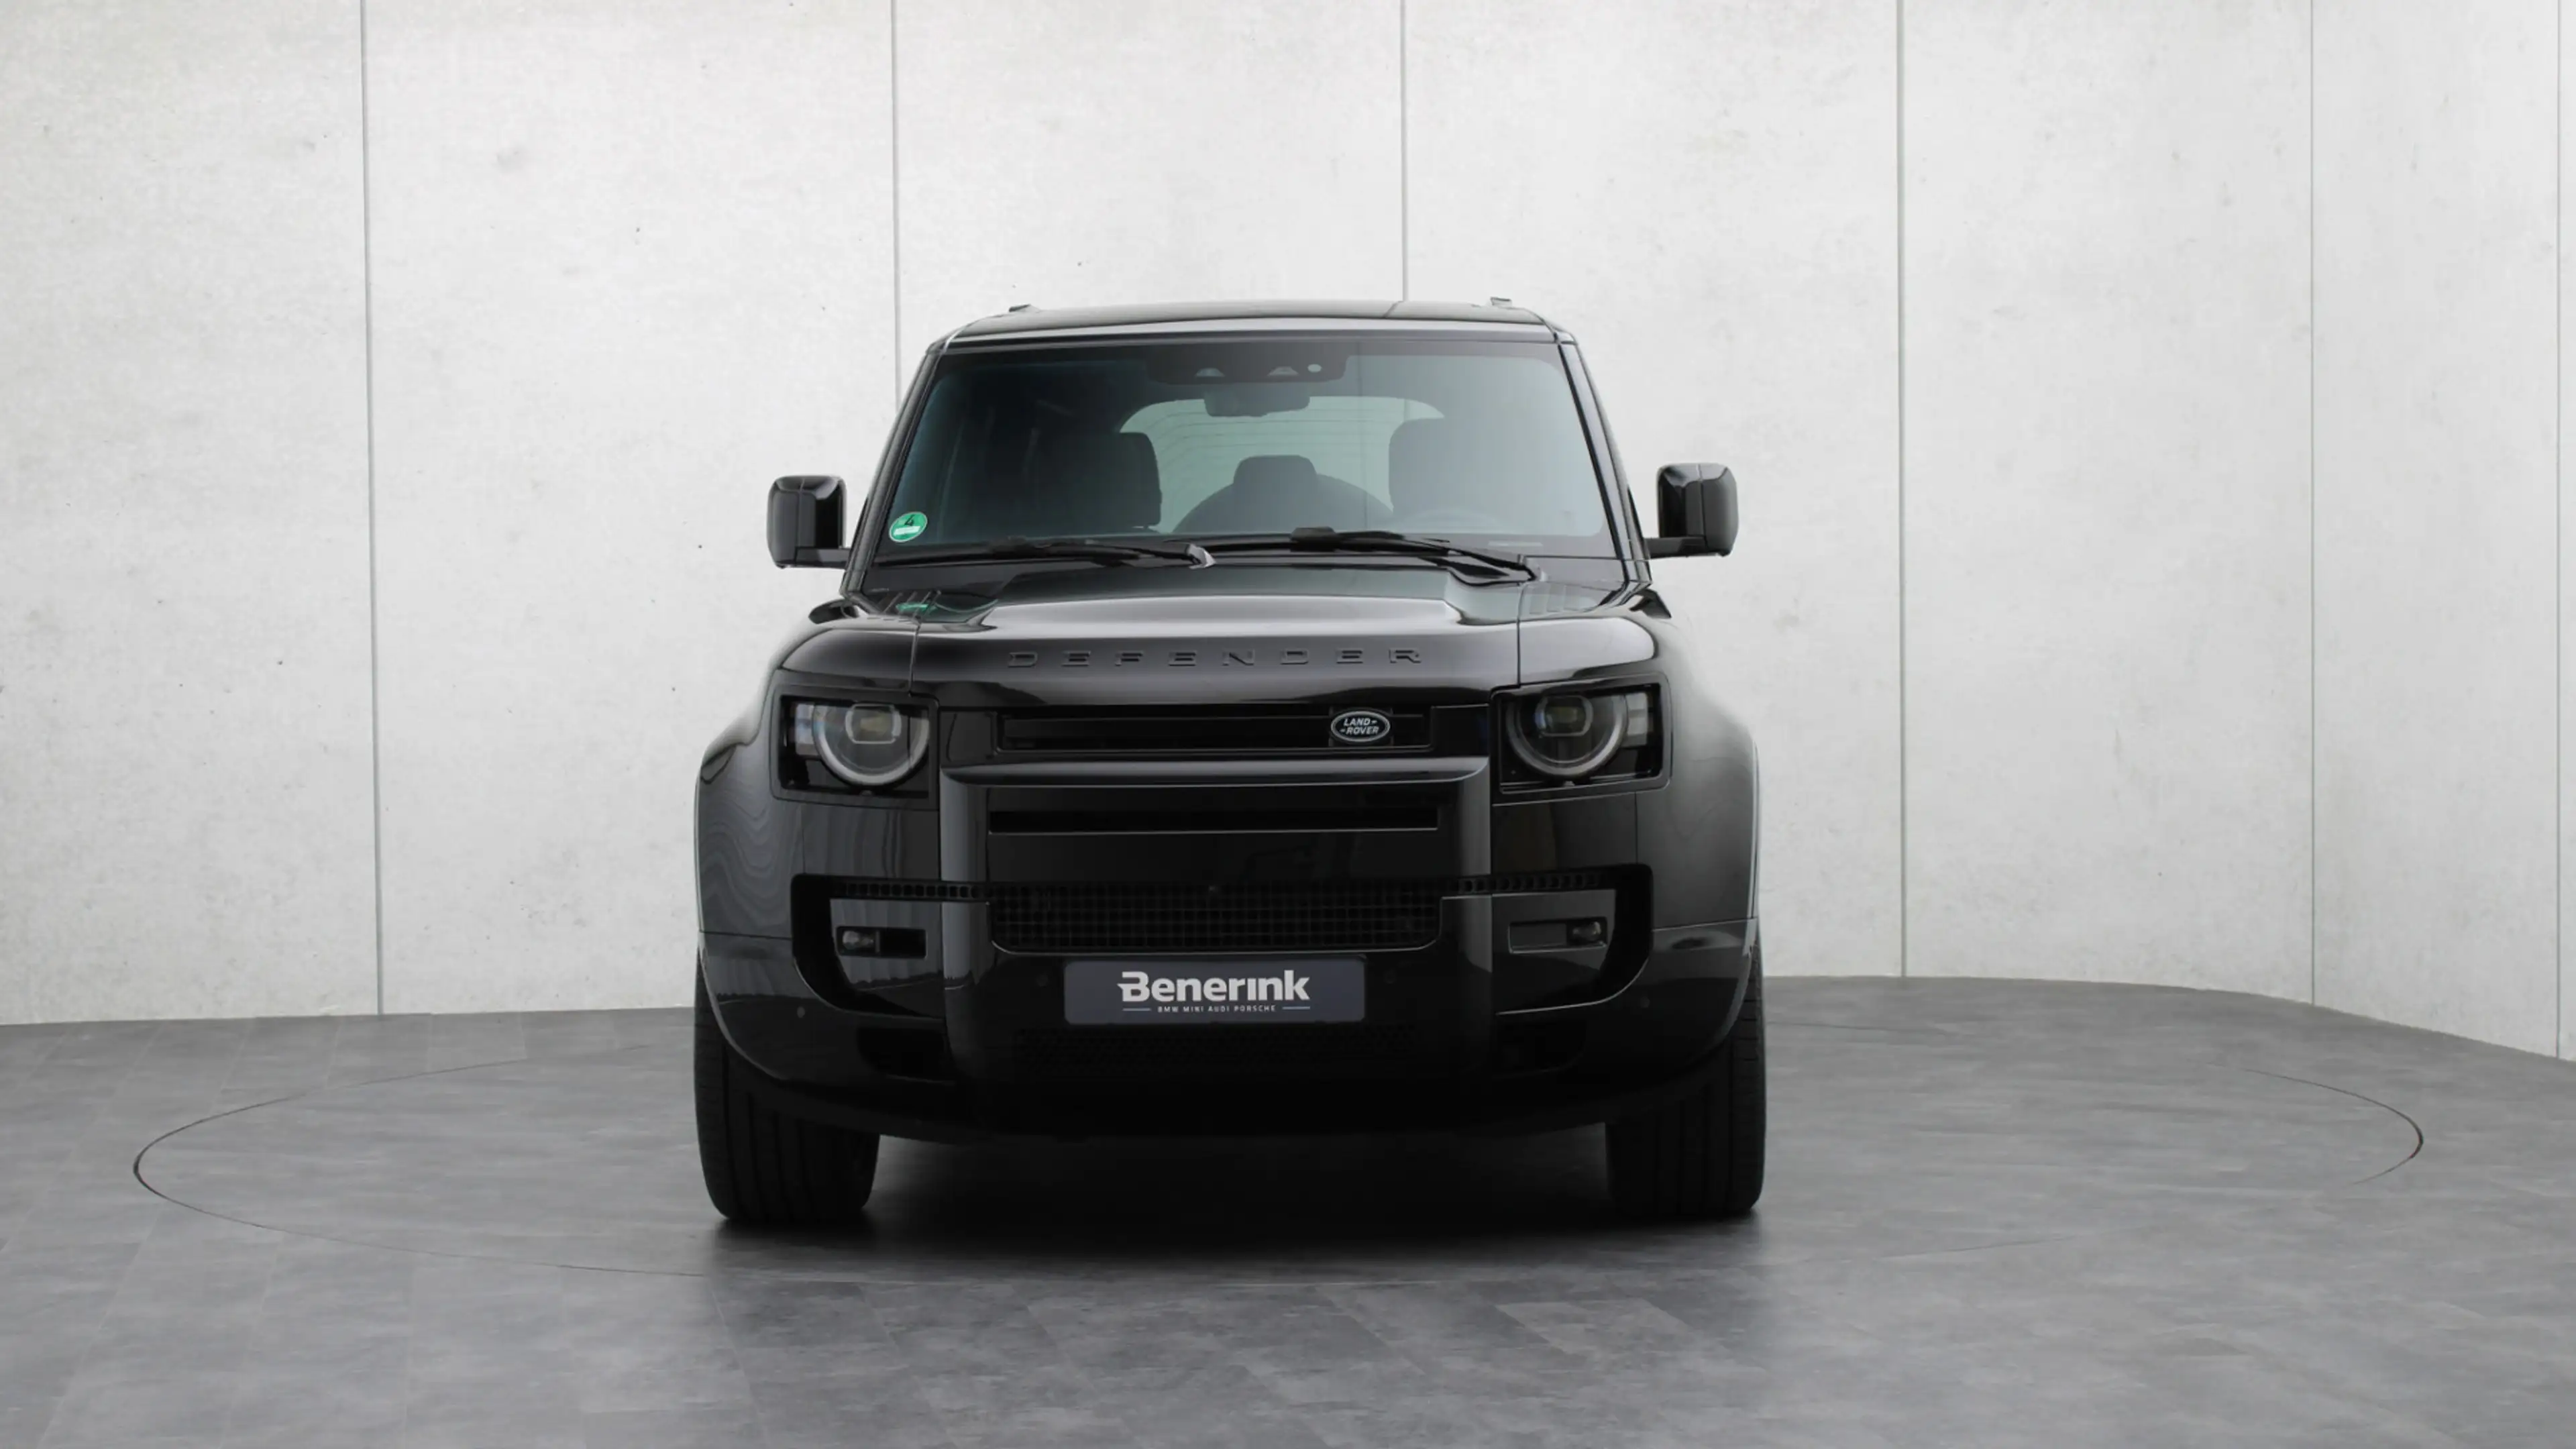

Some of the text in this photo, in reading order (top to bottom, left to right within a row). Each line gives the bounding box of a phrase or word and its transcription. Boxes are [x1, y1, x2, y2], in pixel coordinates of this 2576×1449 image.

[904, 515, 916, 526] 4
[1008, 649, 1421, 667] DEFENDER
[1117, 969, 1310, 1002] Benerink
